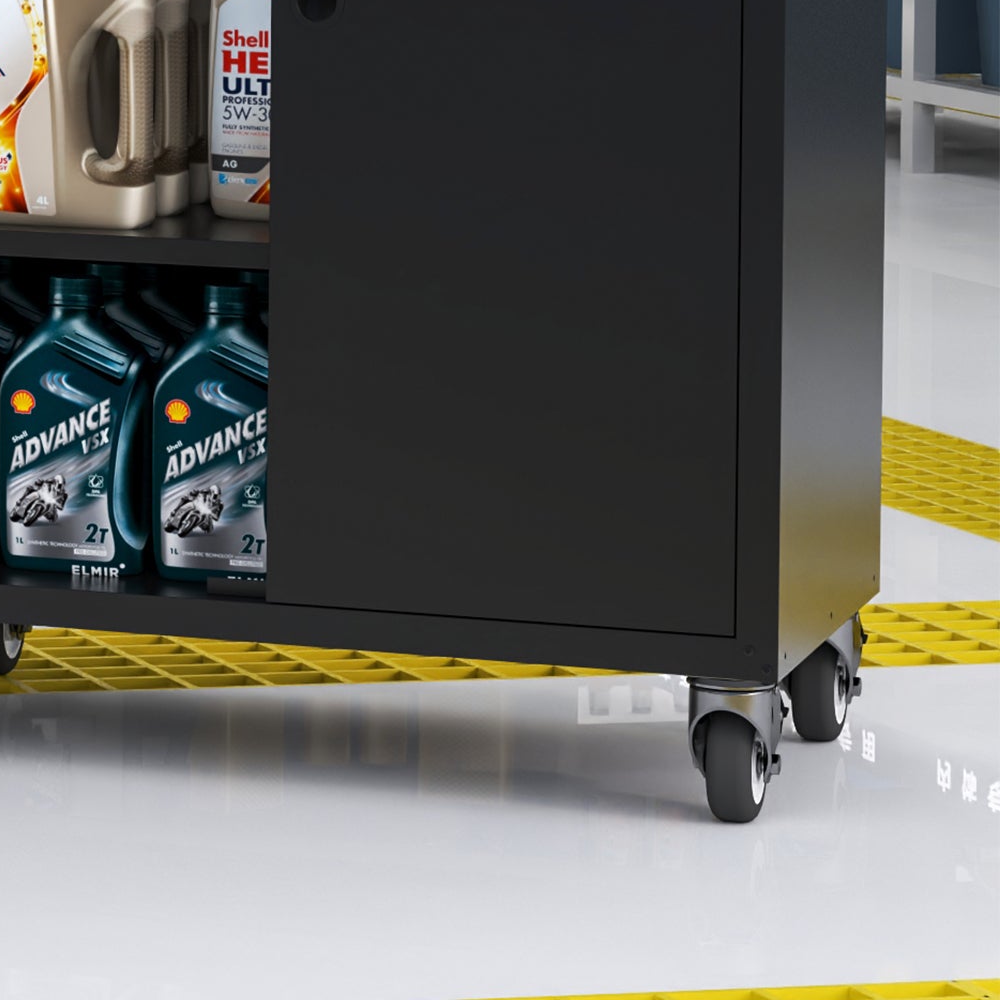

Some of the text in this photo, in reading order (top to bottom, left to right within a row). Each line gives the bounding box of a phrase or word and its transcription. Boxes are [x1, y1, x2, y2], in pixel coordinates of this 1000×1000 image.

[222, 29, 269, 48] Shell
[221, 50, 269, 75] HE
[222, 76, 272, 96] ULT
[222, 105, 271, 122] 5W-3
[222, 159, 238, 169] AG
[36, 195, 49, 206] 4L
[9, 397, 111, 474] ADVANCE
[11, 430, 29, 444] Shell
[81, 427, 110, 455] VSX
[164, 407, 268, 484] ADVANCE
[166, 439, 184, 453] Shell
[237, 436, 266, 465] VSX
[84, 523, 109, 545] 2T
[240, 533, 266, 555] 2T
[71, 563, 120, 578] ELMIR
